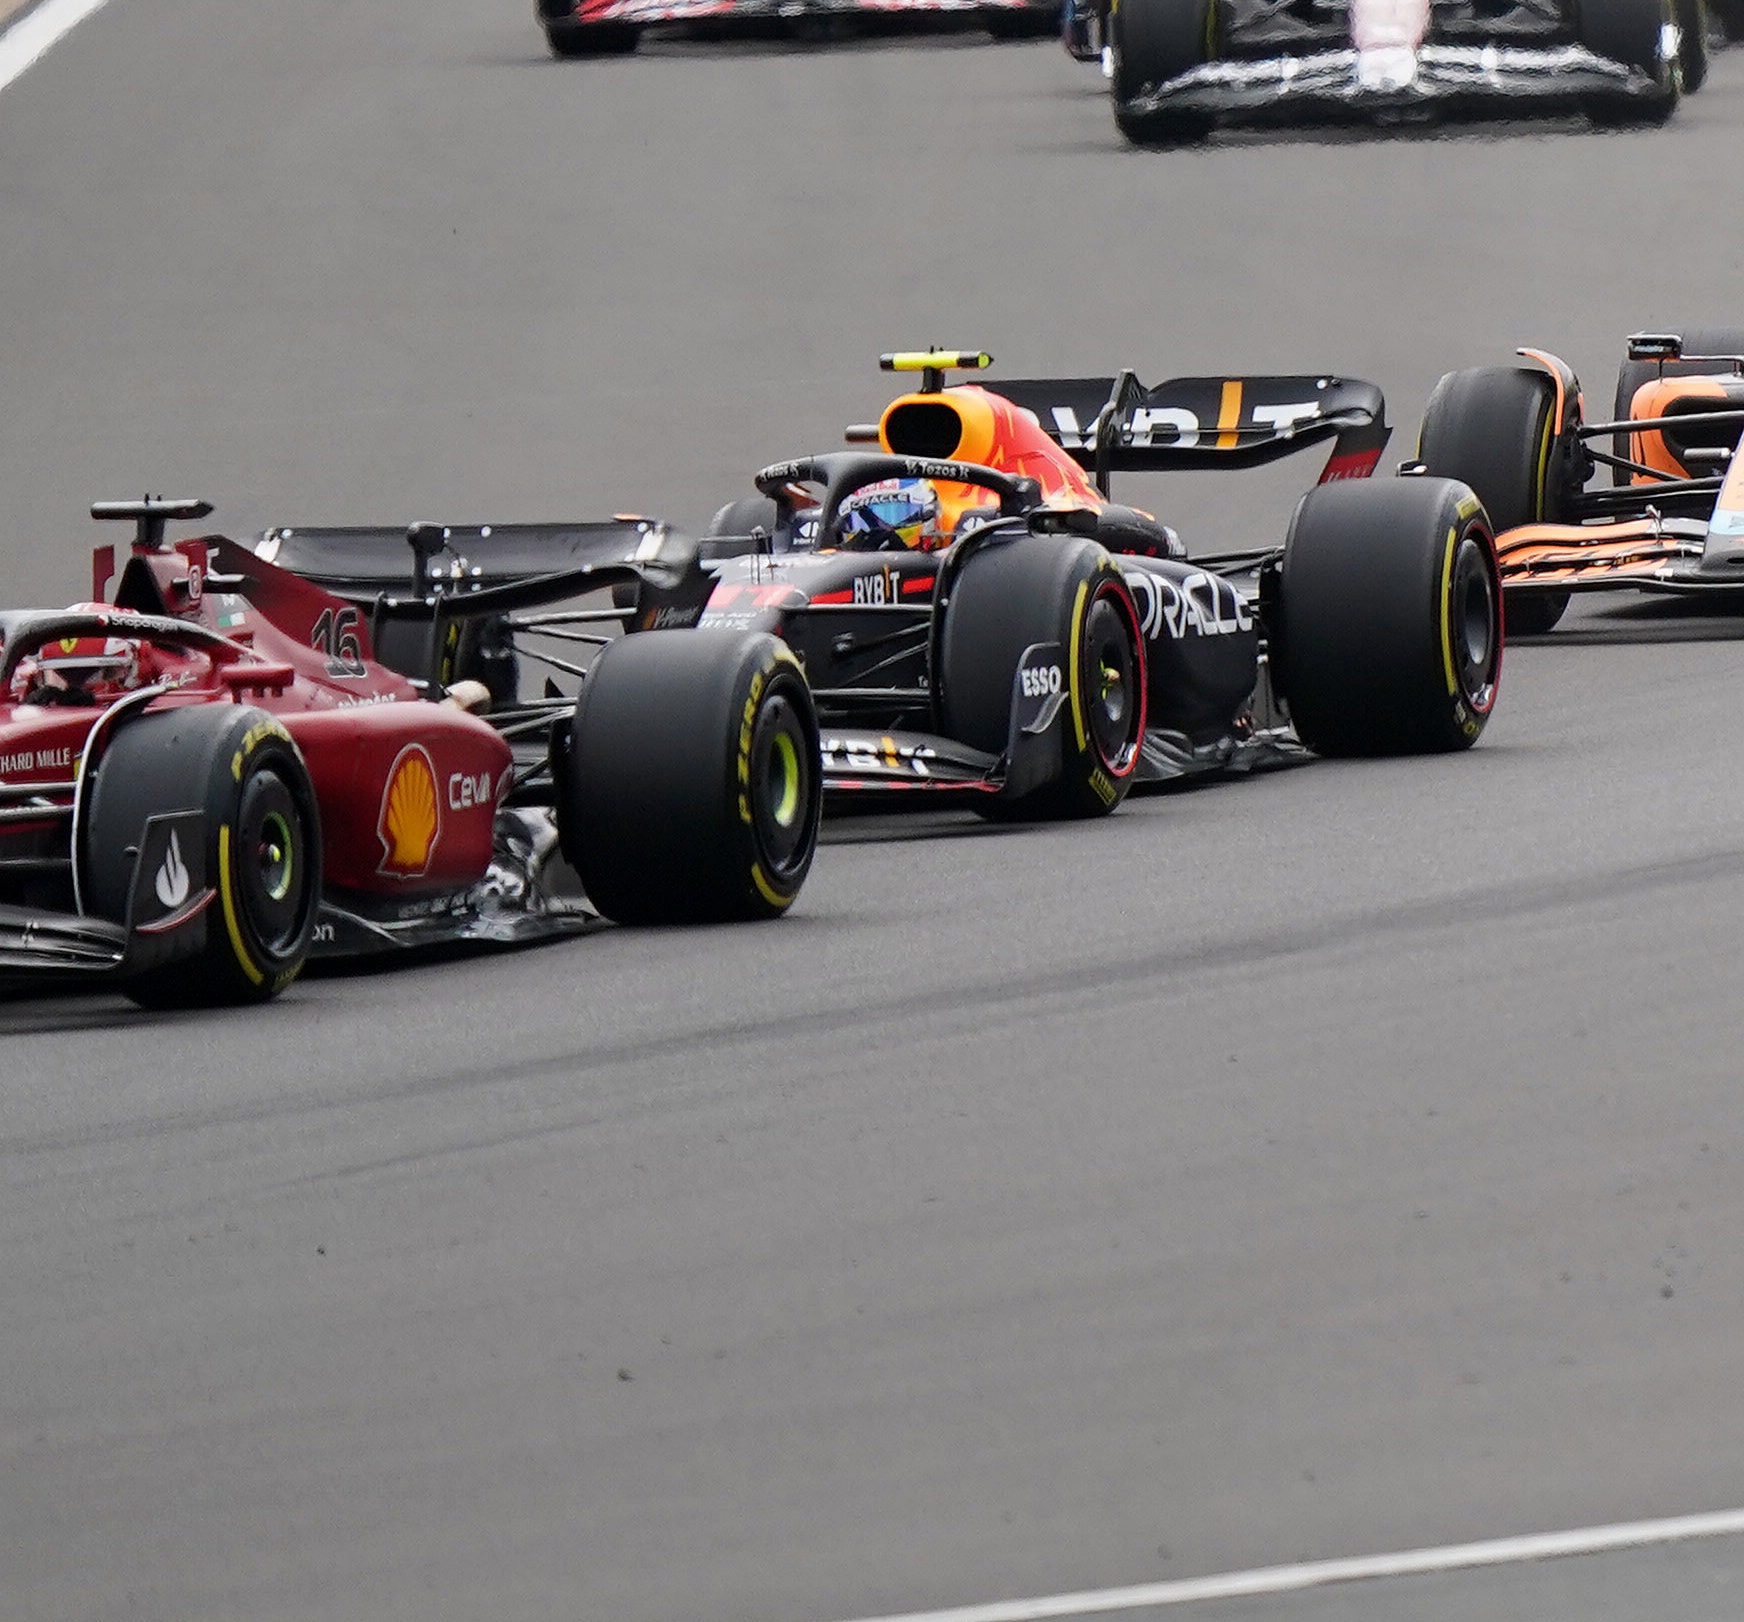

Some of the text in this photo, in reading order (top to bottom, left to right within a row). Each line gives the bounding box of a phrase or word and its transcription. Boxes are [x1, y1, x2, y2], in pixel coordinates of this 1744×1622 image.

[921, 459, 957, 477] Tezos
[311, 606, 368, 678] 16
[1021, 664, 1062, 698] ESSO
[0, 747, 71, 772] HARD MILLE
